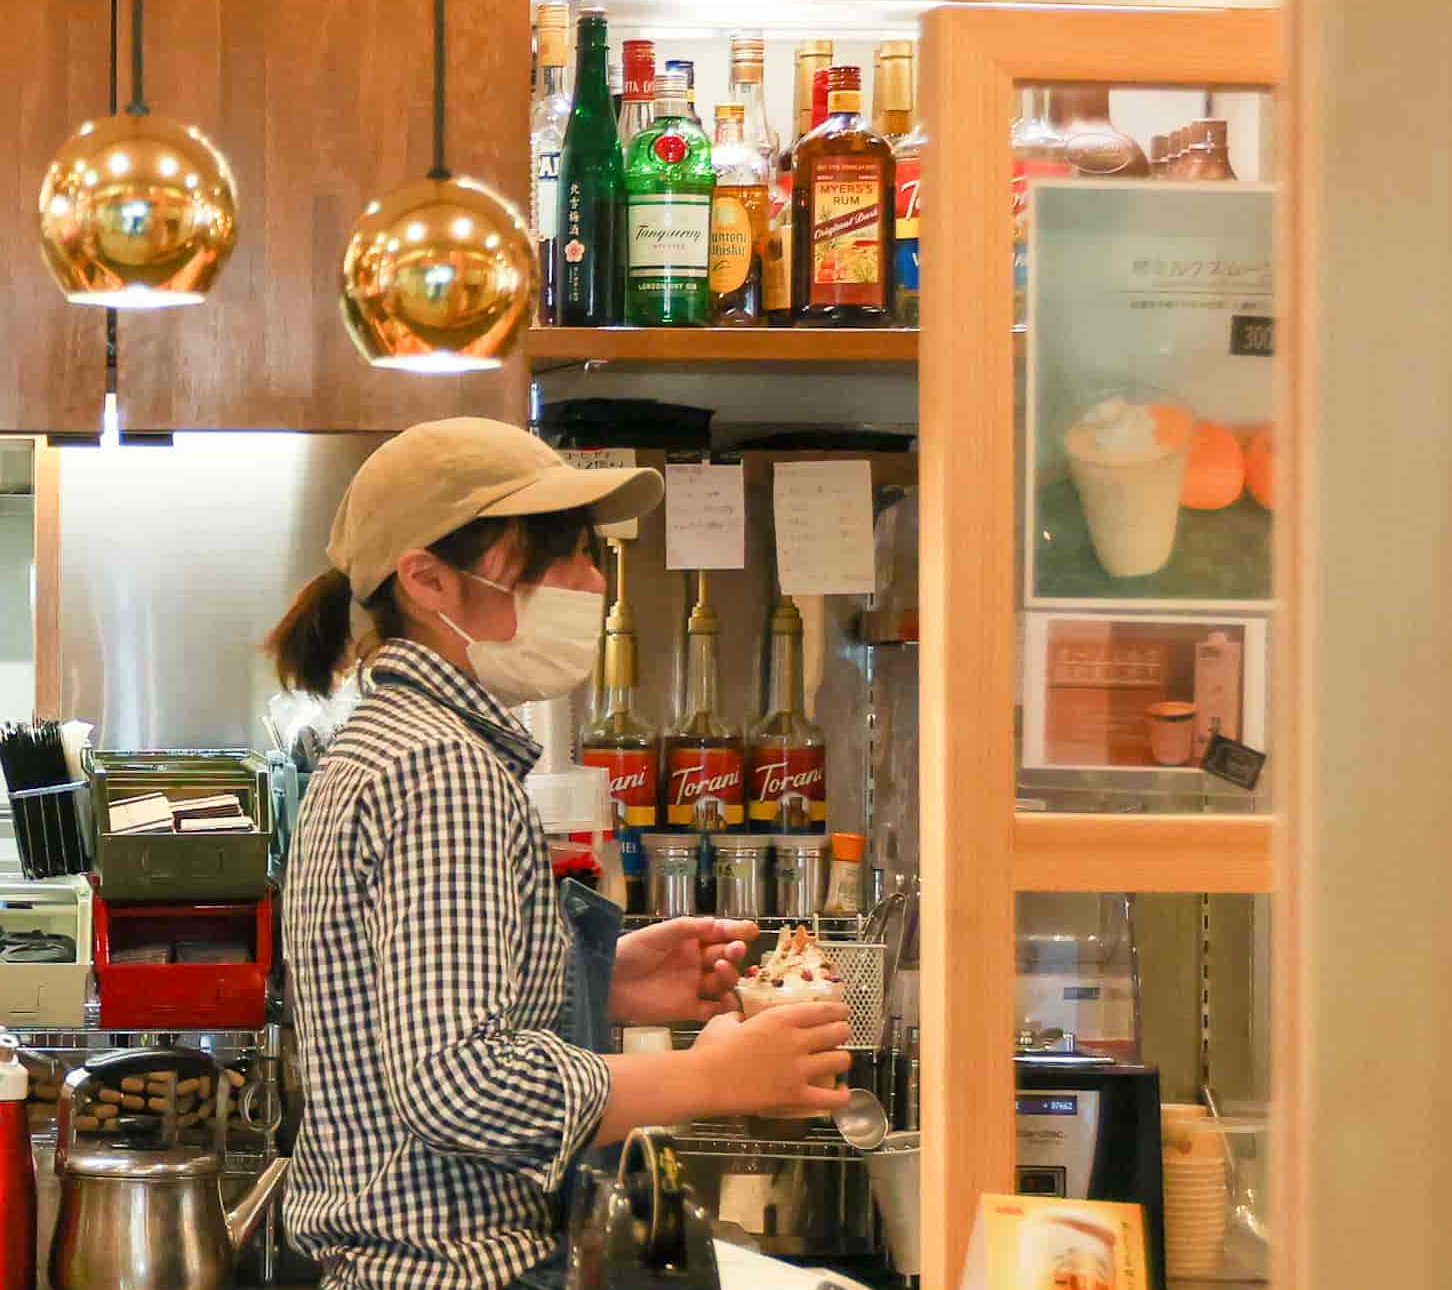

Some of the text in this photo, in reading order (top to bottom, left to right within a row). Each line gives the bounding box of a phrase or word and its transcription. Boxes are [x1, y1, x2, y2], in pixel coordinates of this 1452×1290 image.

[832, 195, 861, 206] RUM
[814, 215, 854, 241] Original
[672, 765, 740, 806] Torani
